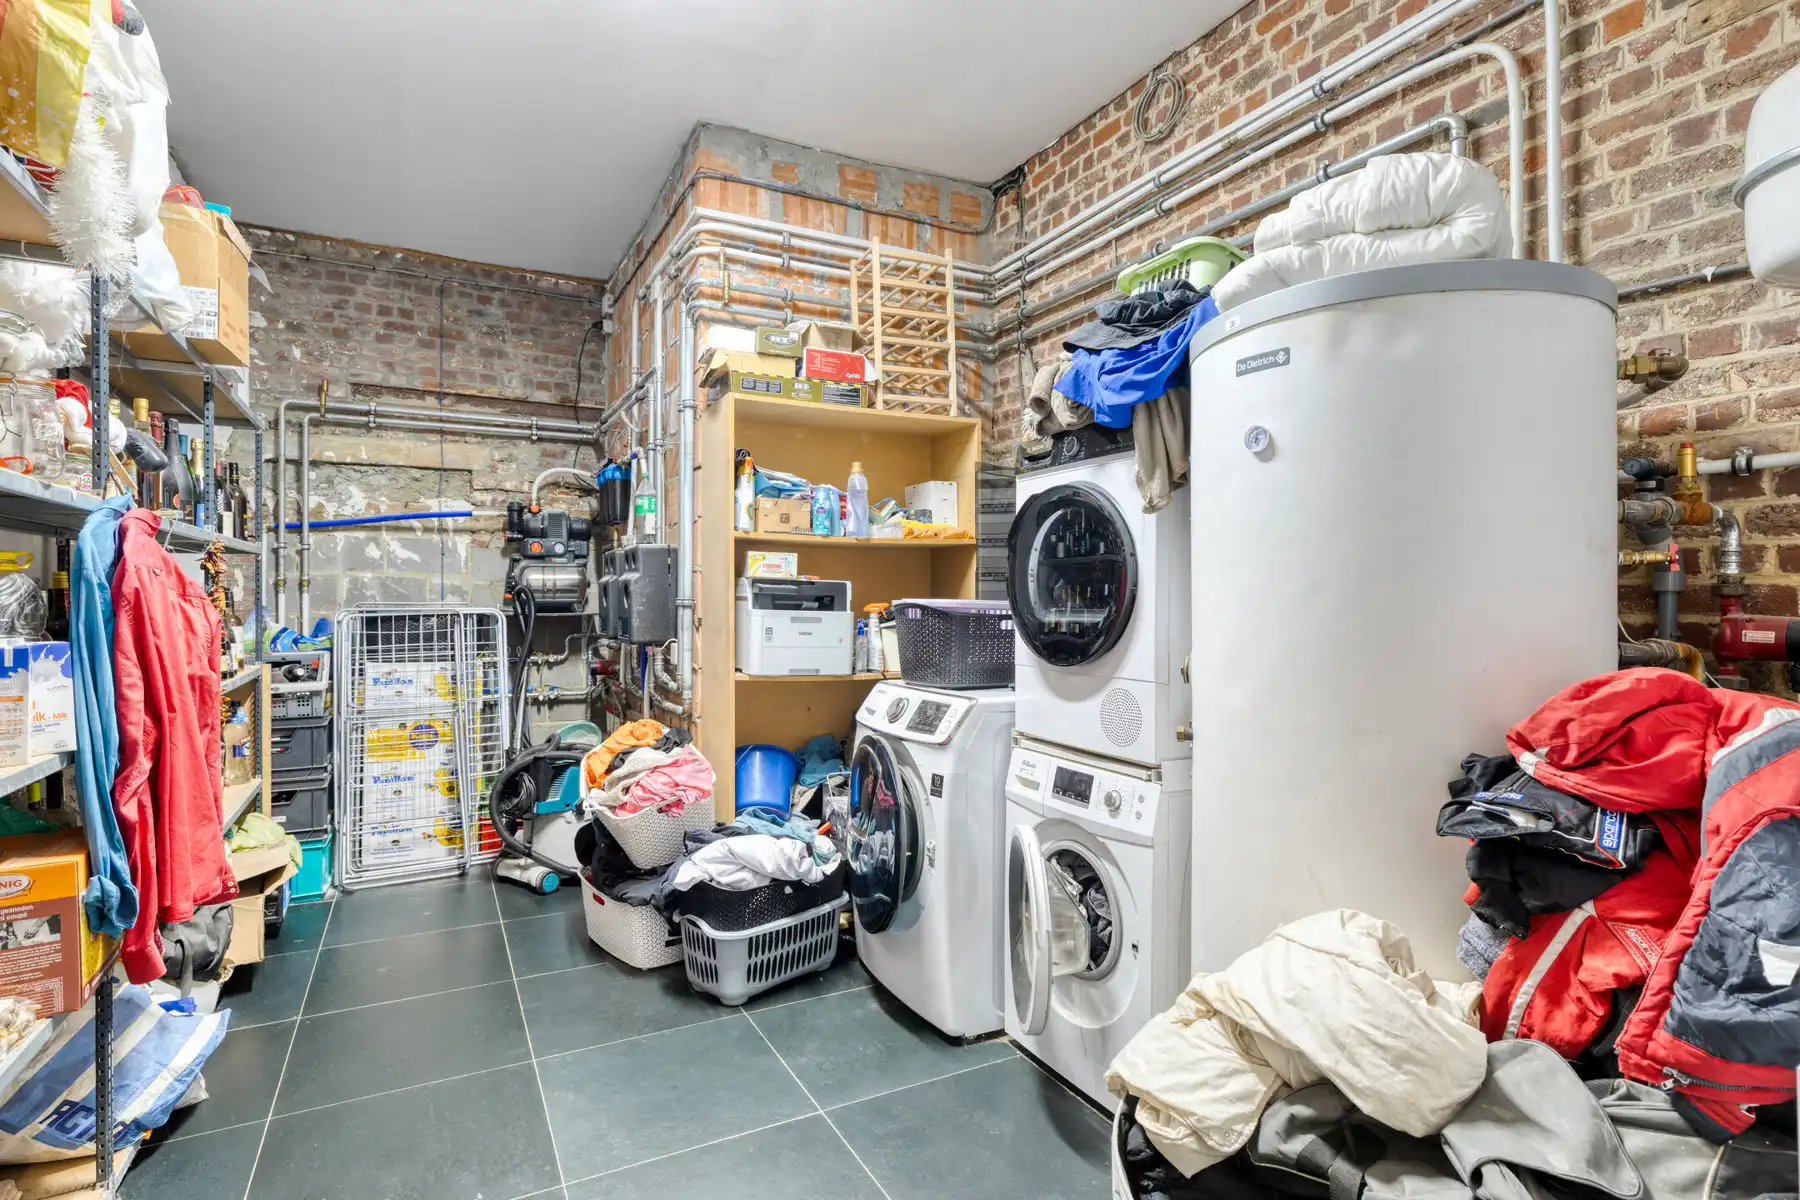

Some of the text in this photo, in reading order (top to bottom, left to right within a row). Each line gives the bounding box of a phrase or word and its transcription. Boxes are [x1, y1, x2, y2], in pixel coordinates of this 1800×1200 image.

[1237, 355, 1275, 372] De Dietrich
[1602, 810, 1619, 848] sparco
